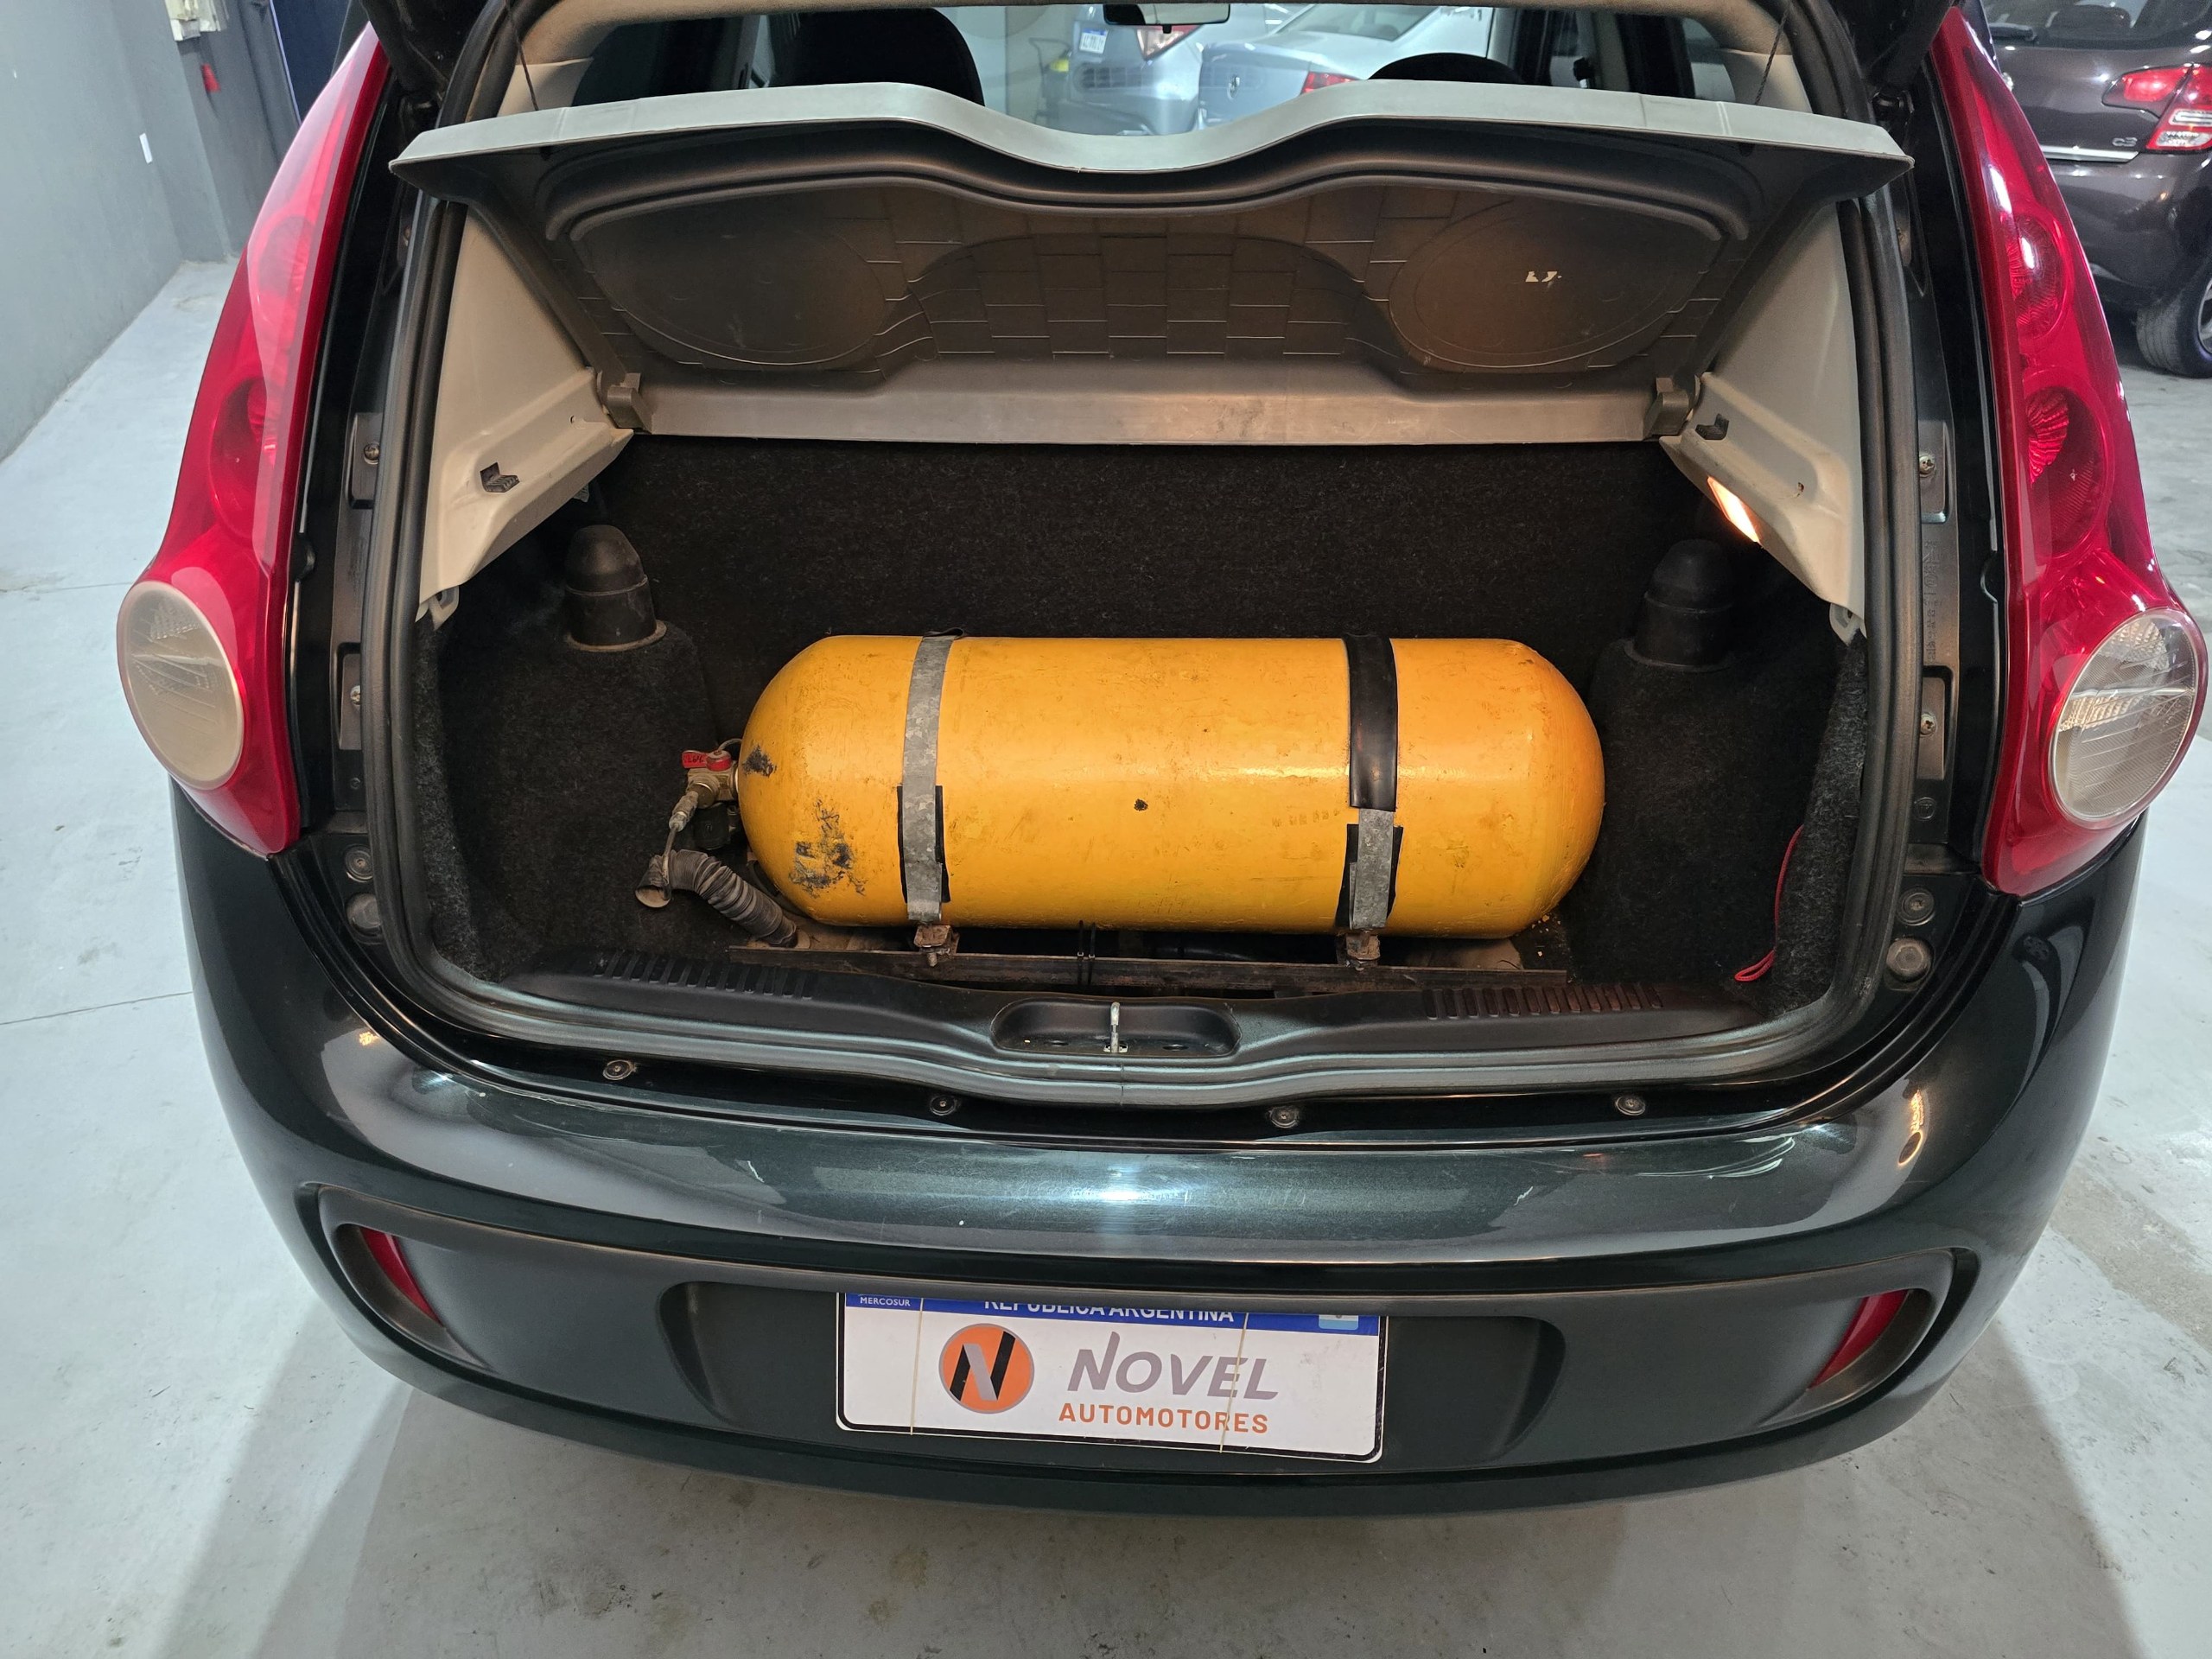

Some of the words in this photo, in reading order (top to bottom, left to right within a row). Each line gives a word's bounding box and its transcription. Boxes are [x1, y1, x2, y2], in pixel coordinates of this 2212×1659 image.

[860, 1296, 911, 1307] MERCOSUR
[1067, 1331, 1279, 1400] NOVEL
[1058, 1402, 1268, 1433] AUTOMOTORES
